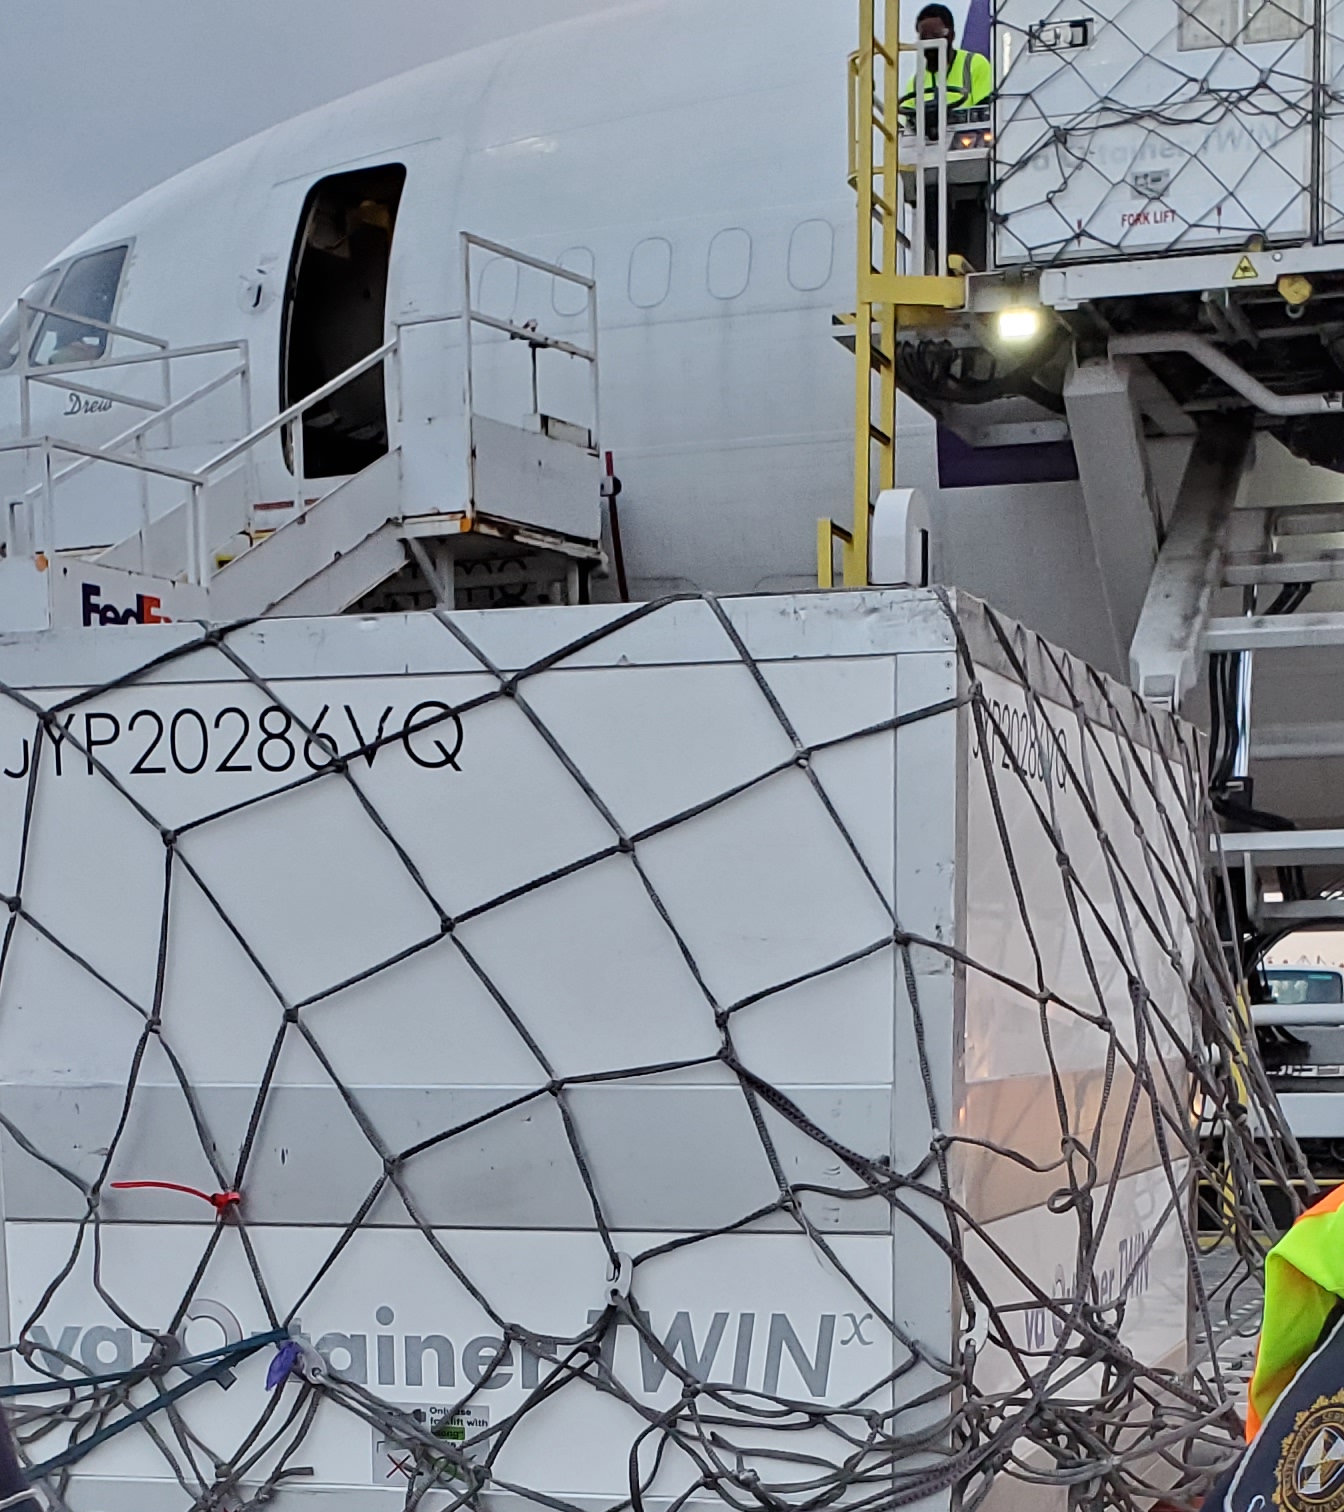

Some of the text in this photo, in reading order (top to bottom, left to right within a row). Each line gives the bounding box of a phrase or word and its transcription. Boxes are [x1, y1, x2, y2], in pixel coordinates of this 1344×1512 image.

[1121, 209, 1177, 228] FORK LIFT
[64, 392, 113, 416] Drew
[82, 582, 173, 627] FedE
[3, 699, 465, 779] JYP20286VQ
[467, 1418, 489, 1428] with
